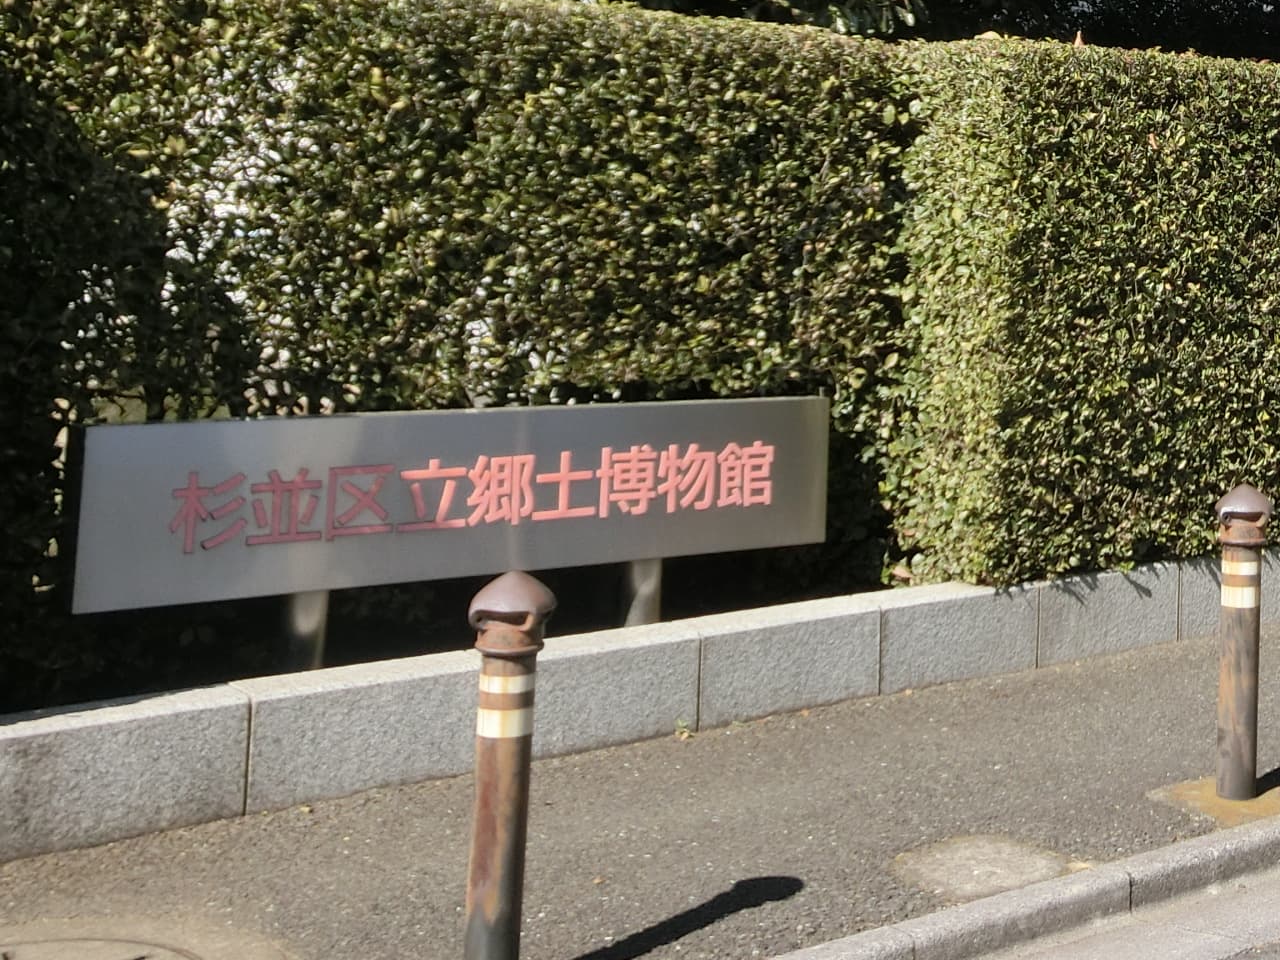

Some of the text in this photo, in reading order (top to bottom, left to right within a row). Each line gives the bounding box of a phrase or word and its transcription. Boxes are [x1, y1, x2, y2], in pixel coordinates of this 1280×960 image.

[169, 440, 775, 554] 杉並区立郷土博物館
